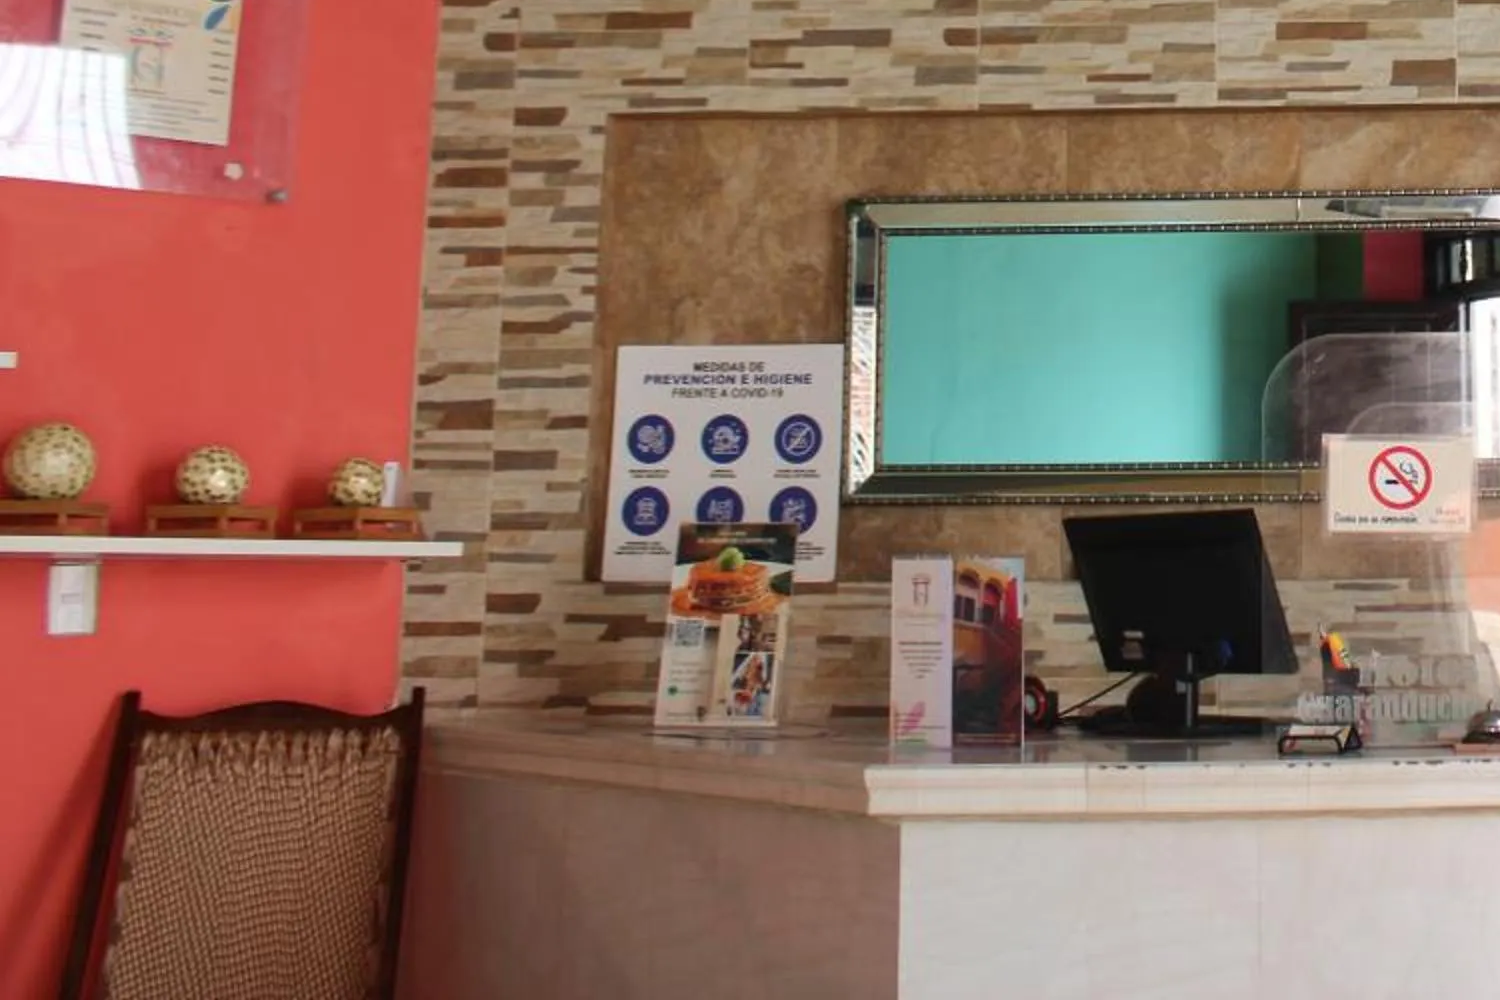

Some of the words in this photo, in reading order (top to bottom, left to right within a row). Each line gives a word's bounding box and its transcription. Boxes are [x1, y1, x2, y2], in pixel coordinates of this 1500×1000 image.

[693, 361, 745, 373] MEDIDAS
[749, 361, 765, 373] DE
[741, 373, 750, 385] E
[753, 373, 813, 385] HIGIENE
[671, 387, 718, 399] FRENTE
[720, 388, 727, 398] A
